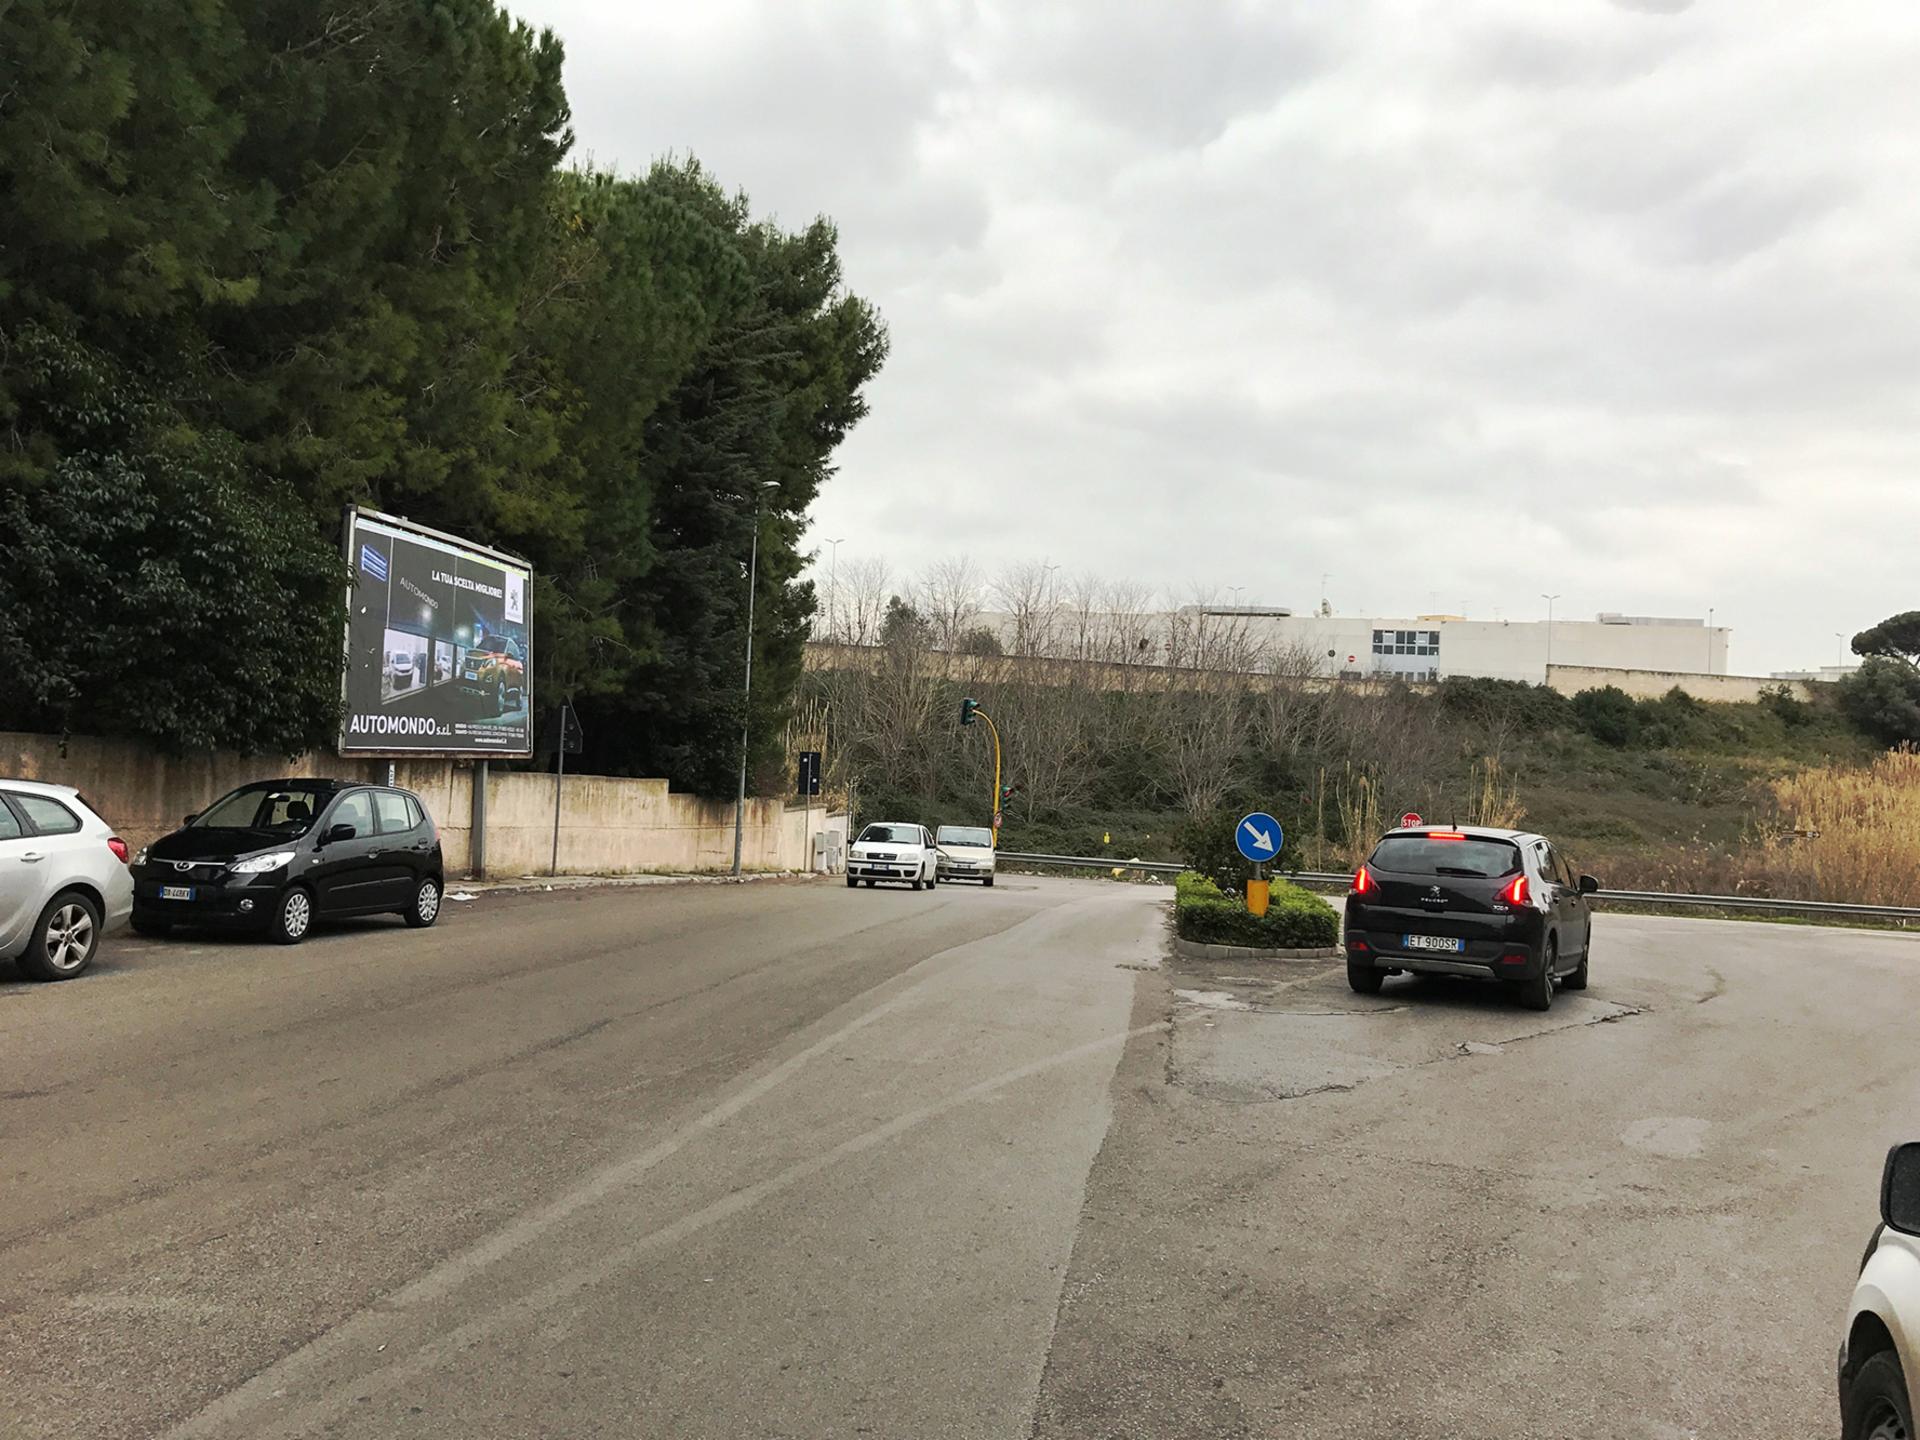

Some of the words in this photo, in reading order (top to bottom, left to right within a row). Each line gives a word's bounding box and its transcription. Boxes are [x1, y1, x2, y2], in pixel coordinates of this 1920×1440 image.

[431, 570, 440, 581] LA
[441, 572, 454, 586] TUA
[454, 576, 474, 590] SCELTA
[400, 577, 439, 609] AUTOMONDO
[349, 714, 435, 735] AUTOMONDO
[1402, 819, 1422, 828] STOP
[1409, 935, 1421, 947] ET
[1425, 936, 1457, 949] 900SR
